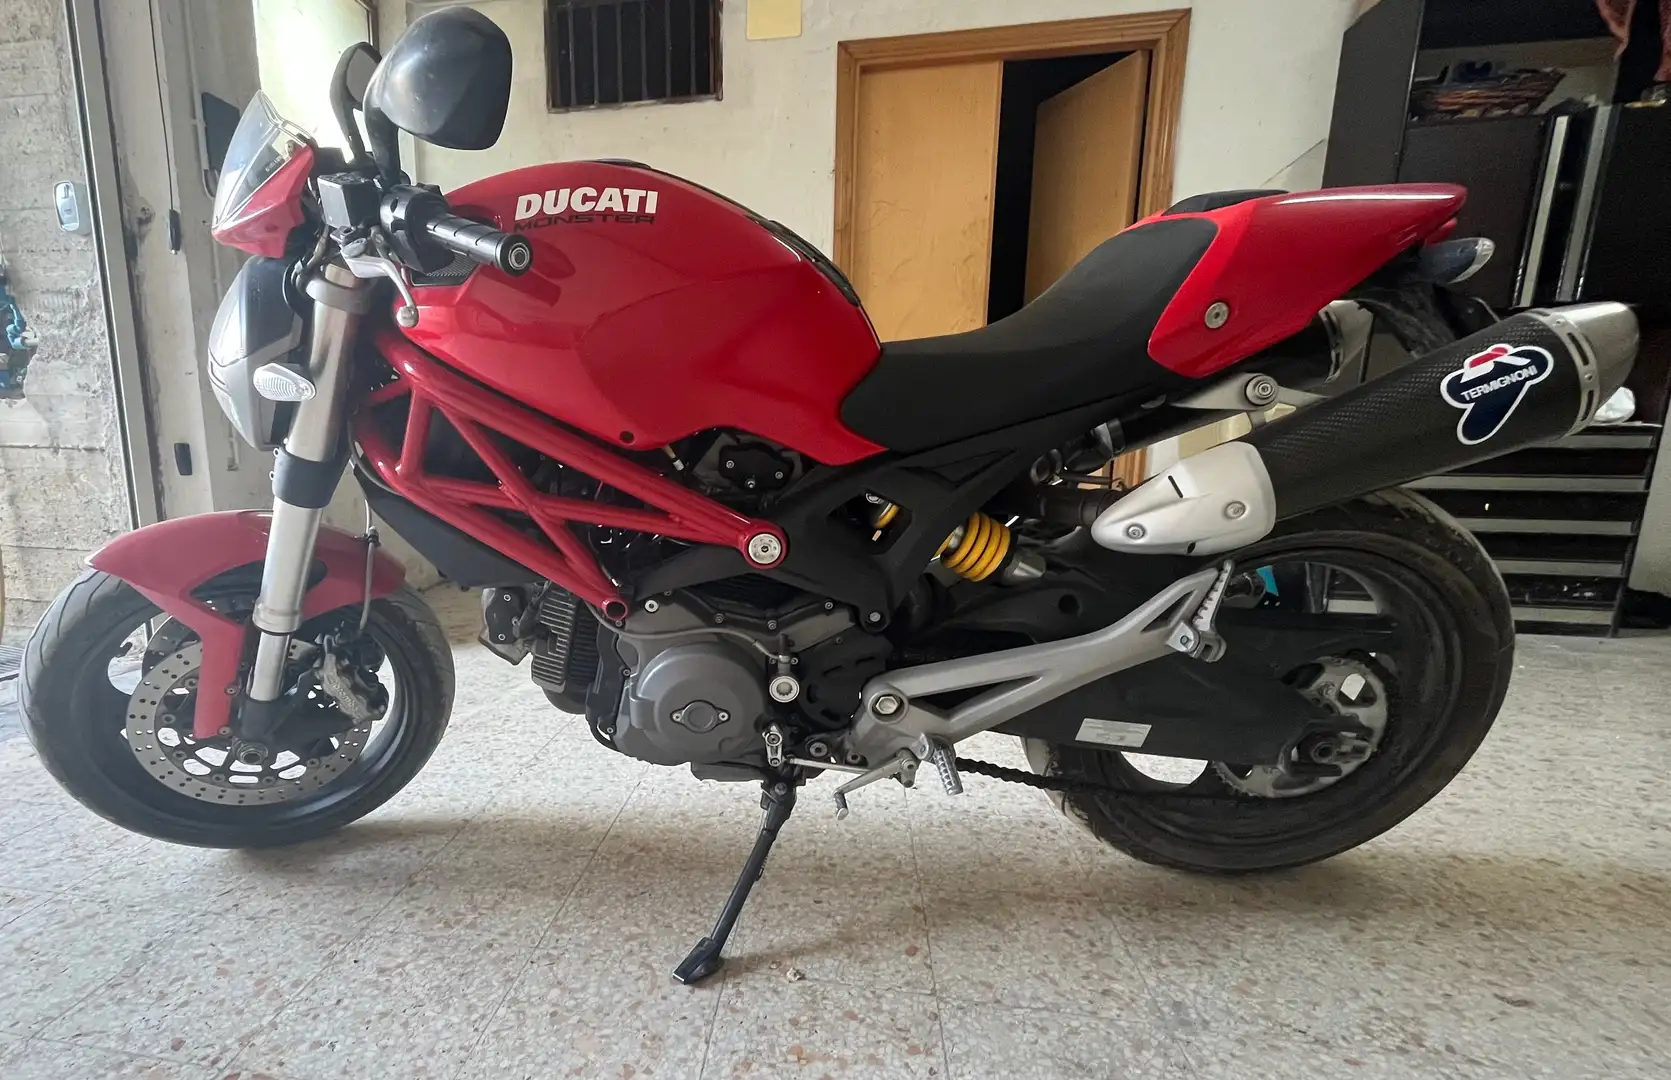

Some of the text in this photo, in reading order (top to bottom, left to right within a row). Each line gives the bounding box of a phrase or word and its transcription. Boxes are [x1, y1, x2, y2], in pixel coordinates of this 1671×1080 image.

[514, 187, 658, 220] DUCATI
[514, 213, 656, 232] MONSTER
[1460, 365, 1538, 401] TERMIGNONI
